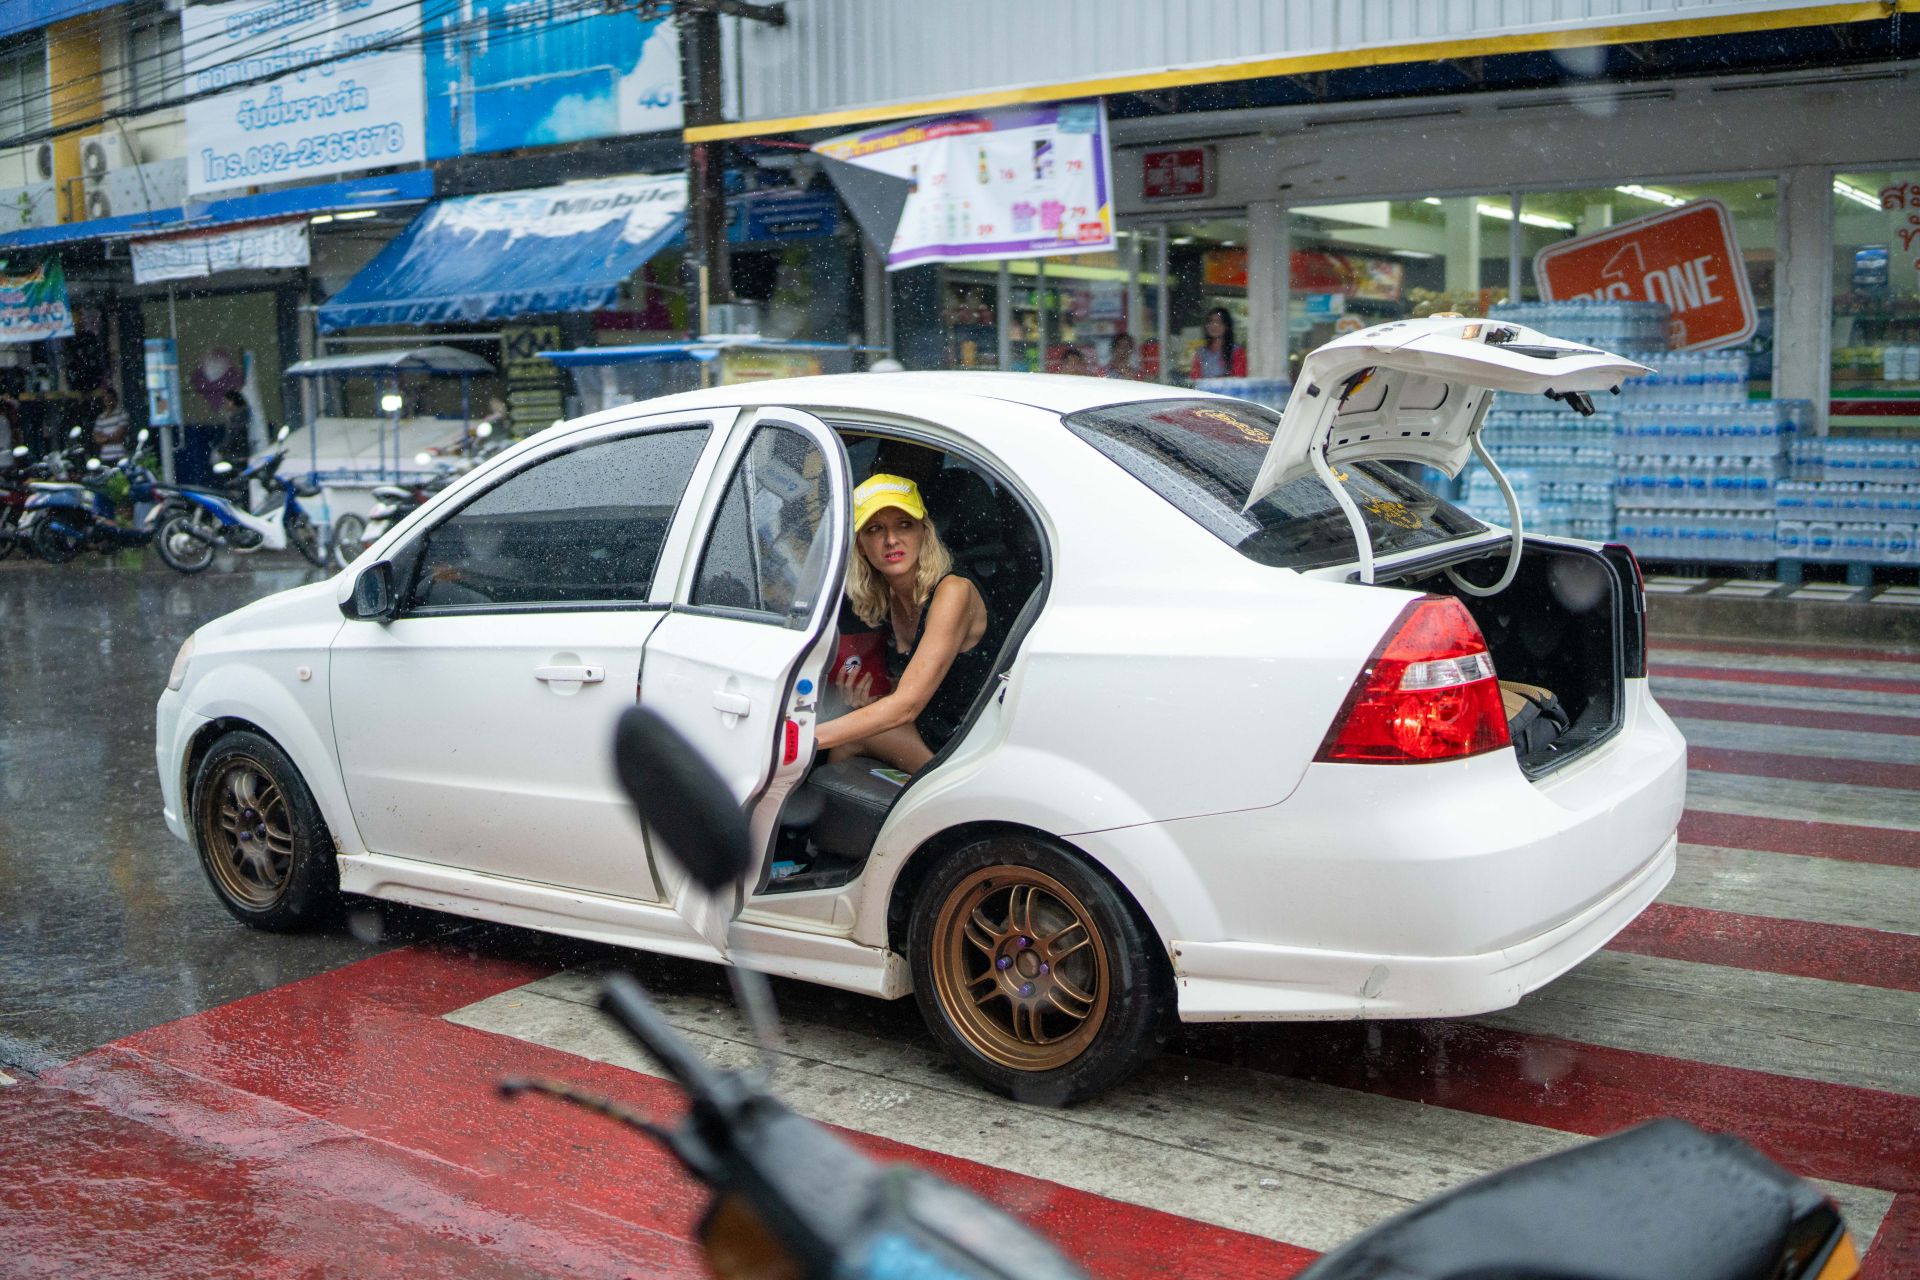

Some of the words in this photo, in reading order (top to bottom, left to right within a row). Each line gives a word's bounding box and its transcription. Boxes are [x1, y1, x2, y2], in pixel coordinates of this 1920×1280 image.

[202, 122, 405, 183] โทร.092-2565678
[549, 187, 681, 216] Mobile
[1643, 254, 1724, 314] ONE
